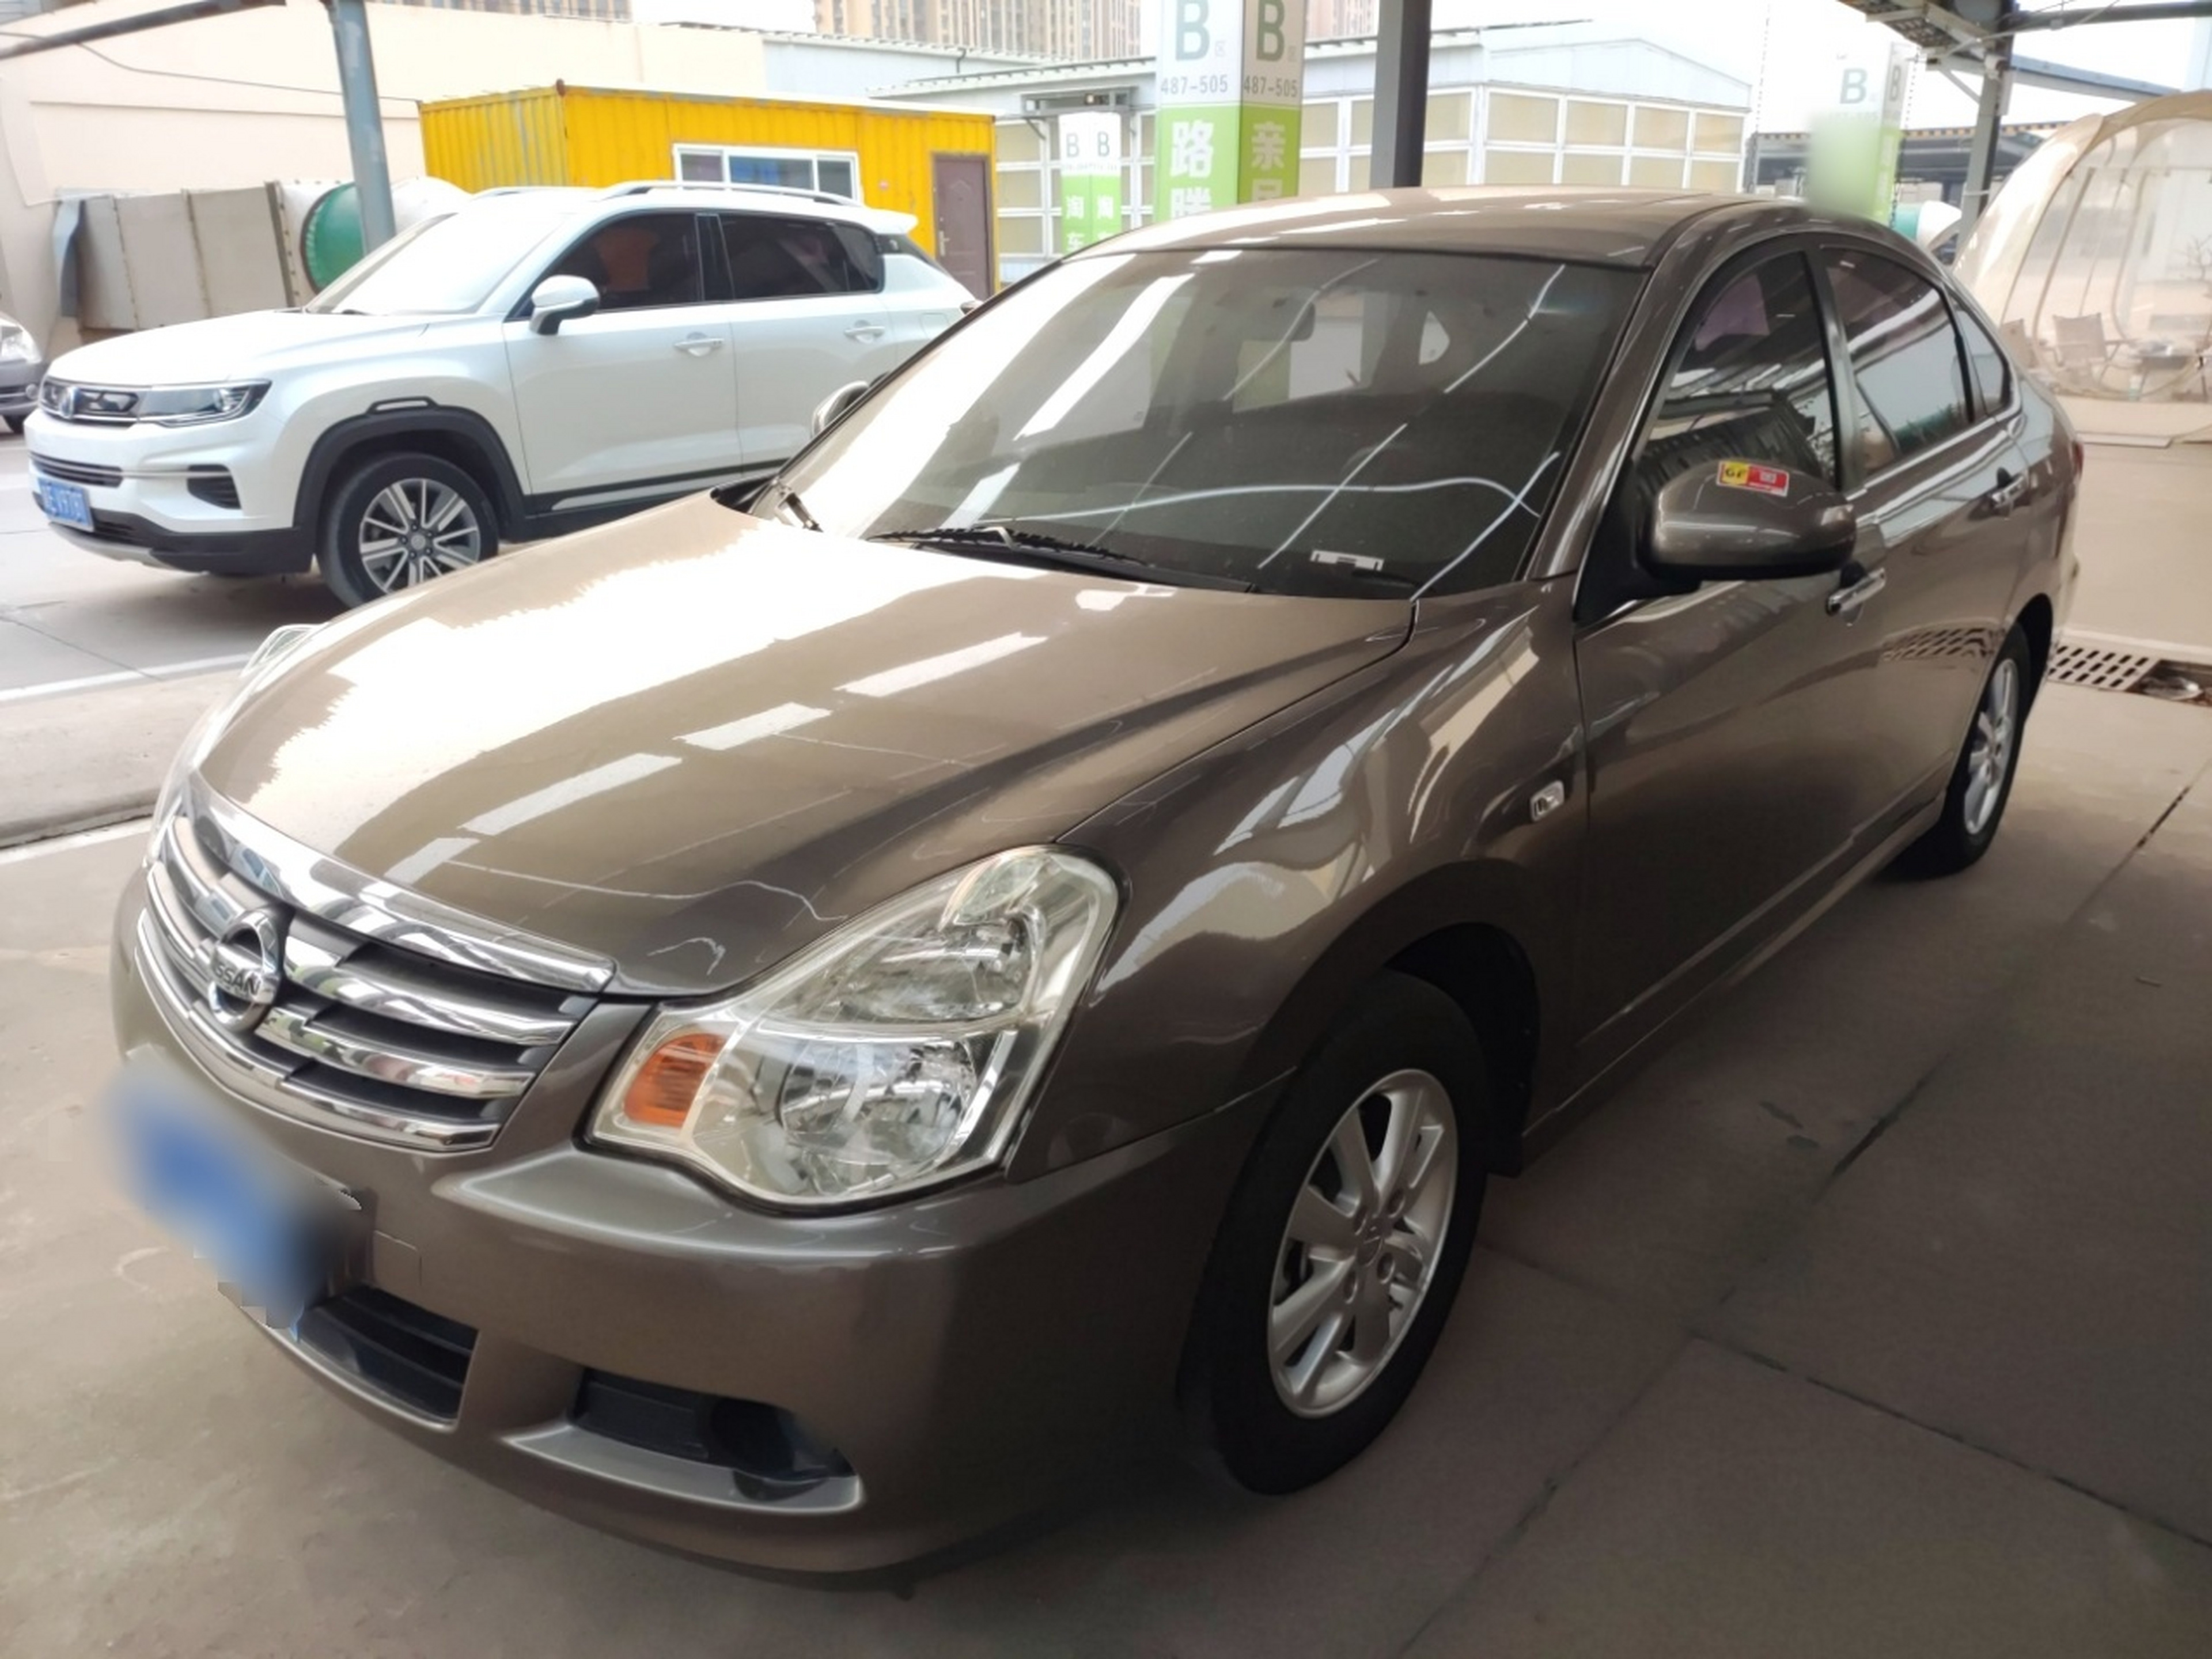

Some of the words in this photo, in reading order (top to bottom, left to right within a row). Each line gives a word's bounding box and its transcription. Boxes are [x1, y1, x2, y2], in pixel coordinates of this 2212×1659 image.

[1176, 0, 1210, 61] B
[1256, 0, 1285, 62] B
[1161, 74, 1228, 95] 487-505
[1244, 75, 1298, 97] 487-505
[1839, 67, 1867, 104] B
[1066, 132, 1080, 157] B
[1097, 131, 1109, 157] B
